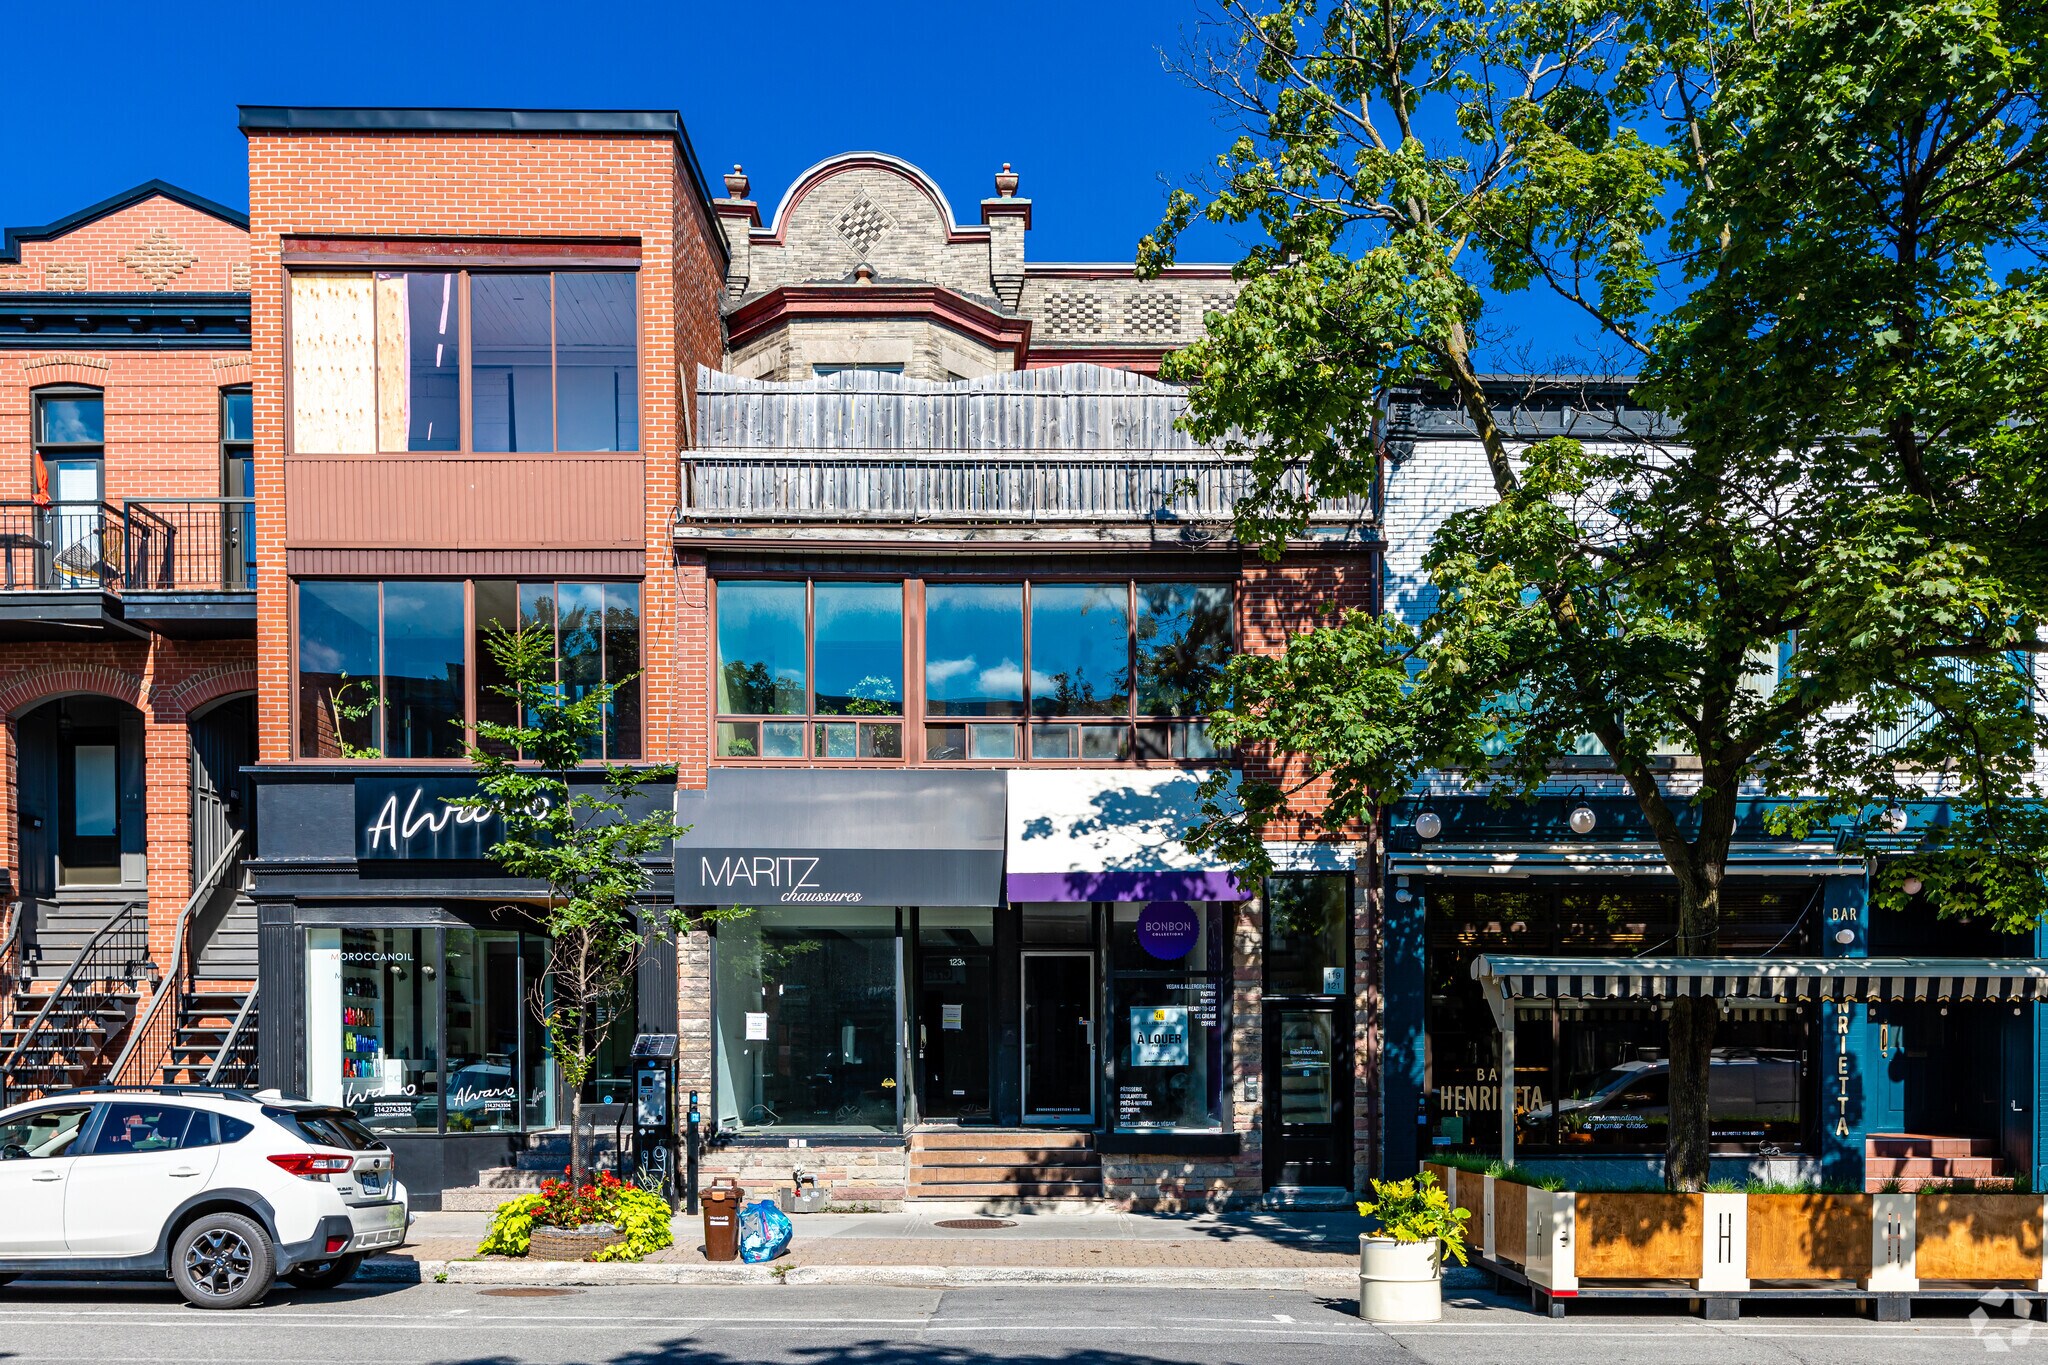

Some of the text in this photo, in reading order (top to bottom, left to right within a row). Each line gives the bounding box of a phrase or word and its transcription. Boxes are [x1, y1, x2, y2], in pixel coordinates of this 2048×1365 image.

[702, 857, 820, 887] MARITZ
[781, 886, 863, 902] chaussures
[1832, 908, 1857, 921] BAR
[1145, 922, 1191, 931] BONBON
[330, 952, 414, 961] MOROCCANOIL
[949, 958, 966, 966] 123A
[1138, 1032, 1182, 1044] À LOUER
[1477, 1068, 1499, 1081] BA
[1836, 1003, 1850, 1136] NRIETTA
[453, 1085, 514, 1107] Alvaro
[1440, 1085, 1543, 1111] HENRITTA
[1593, 1122, 1624, 1131] premier
[1719, 1213, 1731, 1264] H
[1887, 1212, 1901, 1264] H
